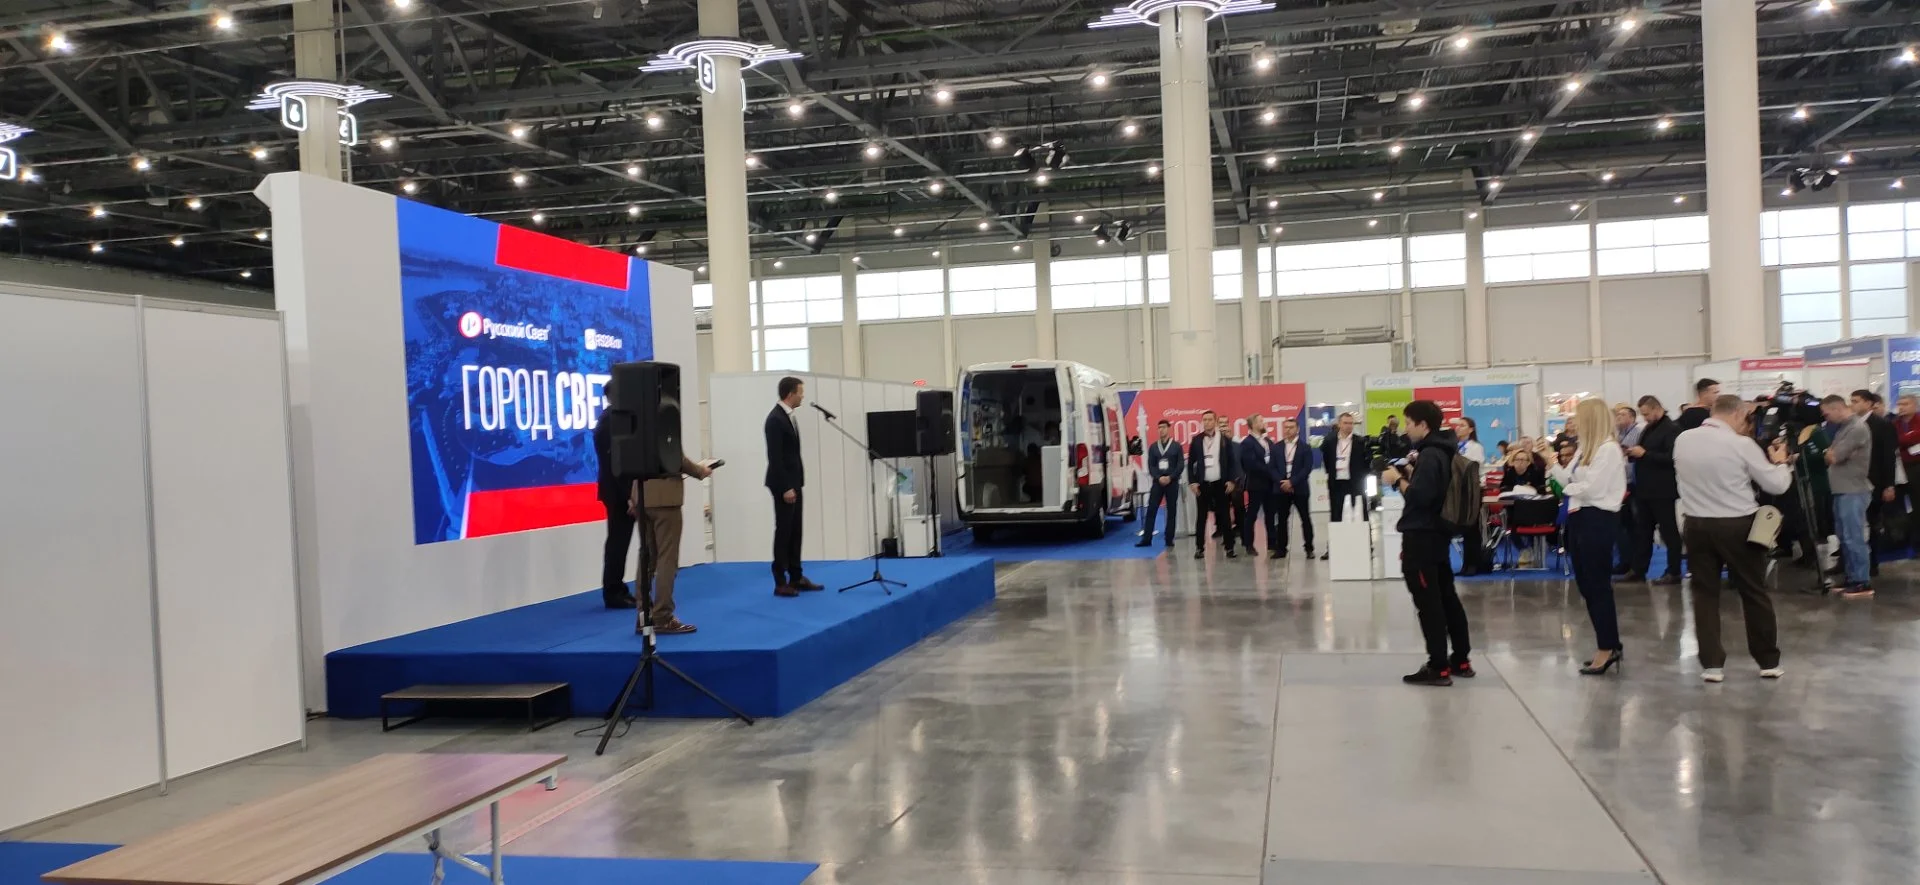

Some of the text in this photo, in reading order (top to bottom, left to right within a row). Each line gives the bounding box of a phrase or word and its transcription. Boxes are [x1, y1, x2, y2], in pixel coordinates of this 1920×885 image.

[703, 62, 711, 84] 5
[289, 103, 301, 123] 6
[482, 317, 549, 341] Русский Свет
[461, 364, 613, 441] ГОРОД СВЕ
[1467, 396, 1512, 407] VOLSTEN
